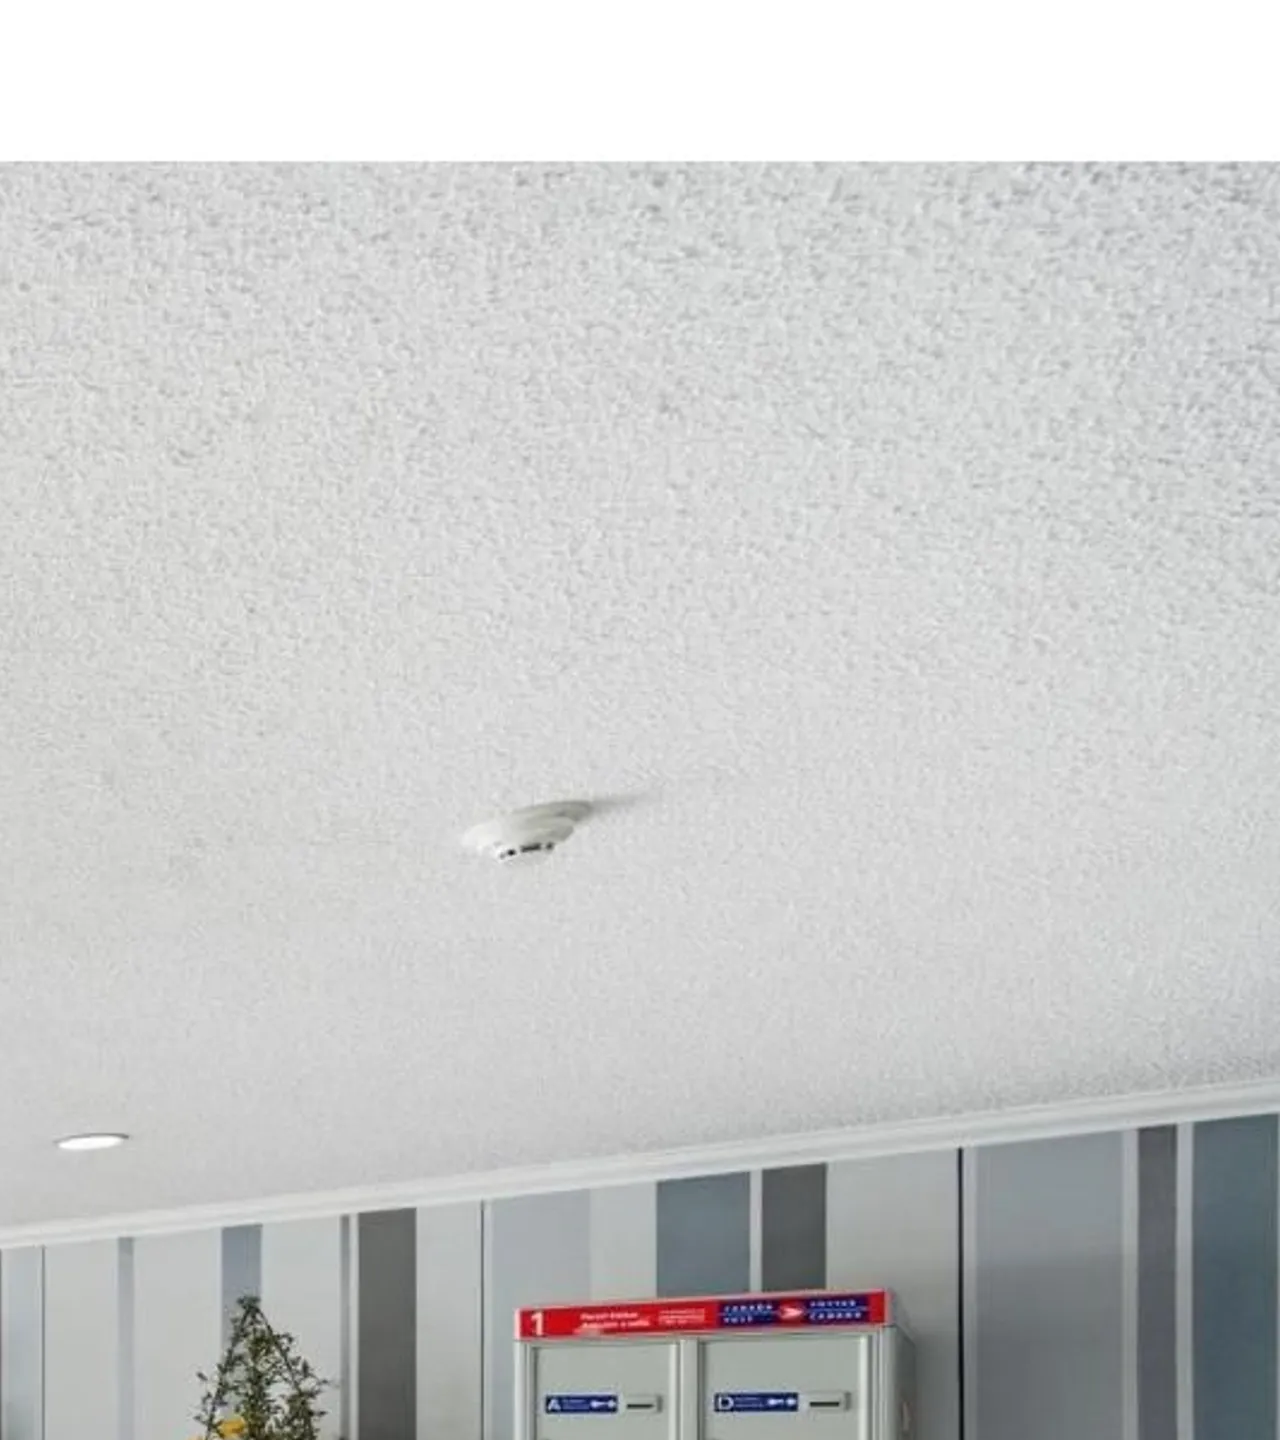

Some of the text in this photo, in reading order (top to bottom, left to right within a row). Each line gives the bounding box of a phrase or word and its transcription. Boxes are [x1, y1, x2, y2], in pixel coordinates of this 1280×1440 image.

[531, 1312, 545, 1336] 1
[548, 1399, 561, 1411] A
[719, 1397, 734, 1410] D
